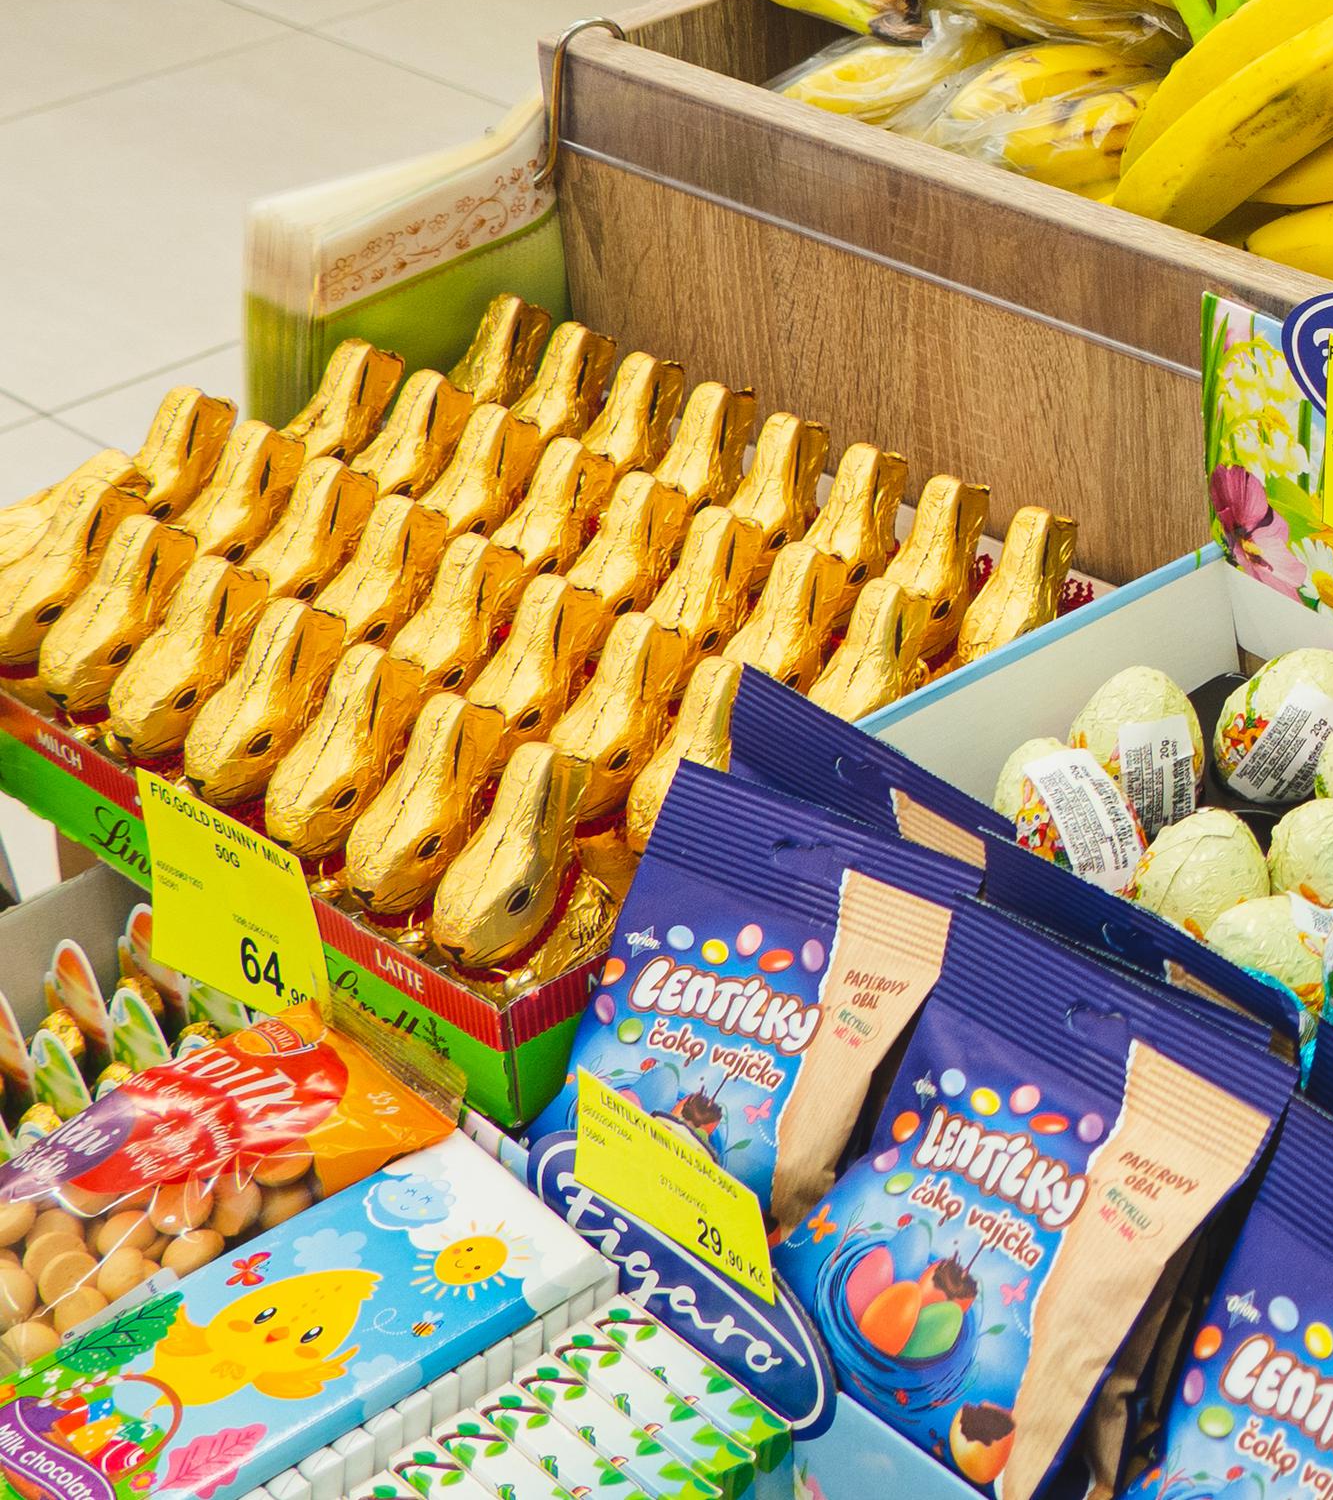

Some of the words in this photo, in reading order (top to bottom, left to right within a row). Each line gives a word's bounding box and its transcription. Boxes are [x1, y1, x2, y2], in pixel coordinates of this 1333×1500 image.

[89, 805, 152, 877] Lin
[212, 817, 259, 854] BUNNY
[261, 844, 295, 877] MILK
[214, 843, 242, 869] 50G
[373, 948, 425, 997] LATTE
[261, 1020, 296, 1051] SEDITA
[46, 1110, 121, 1157] ini
[1124, 1174, 1160, 1201] OBAL
